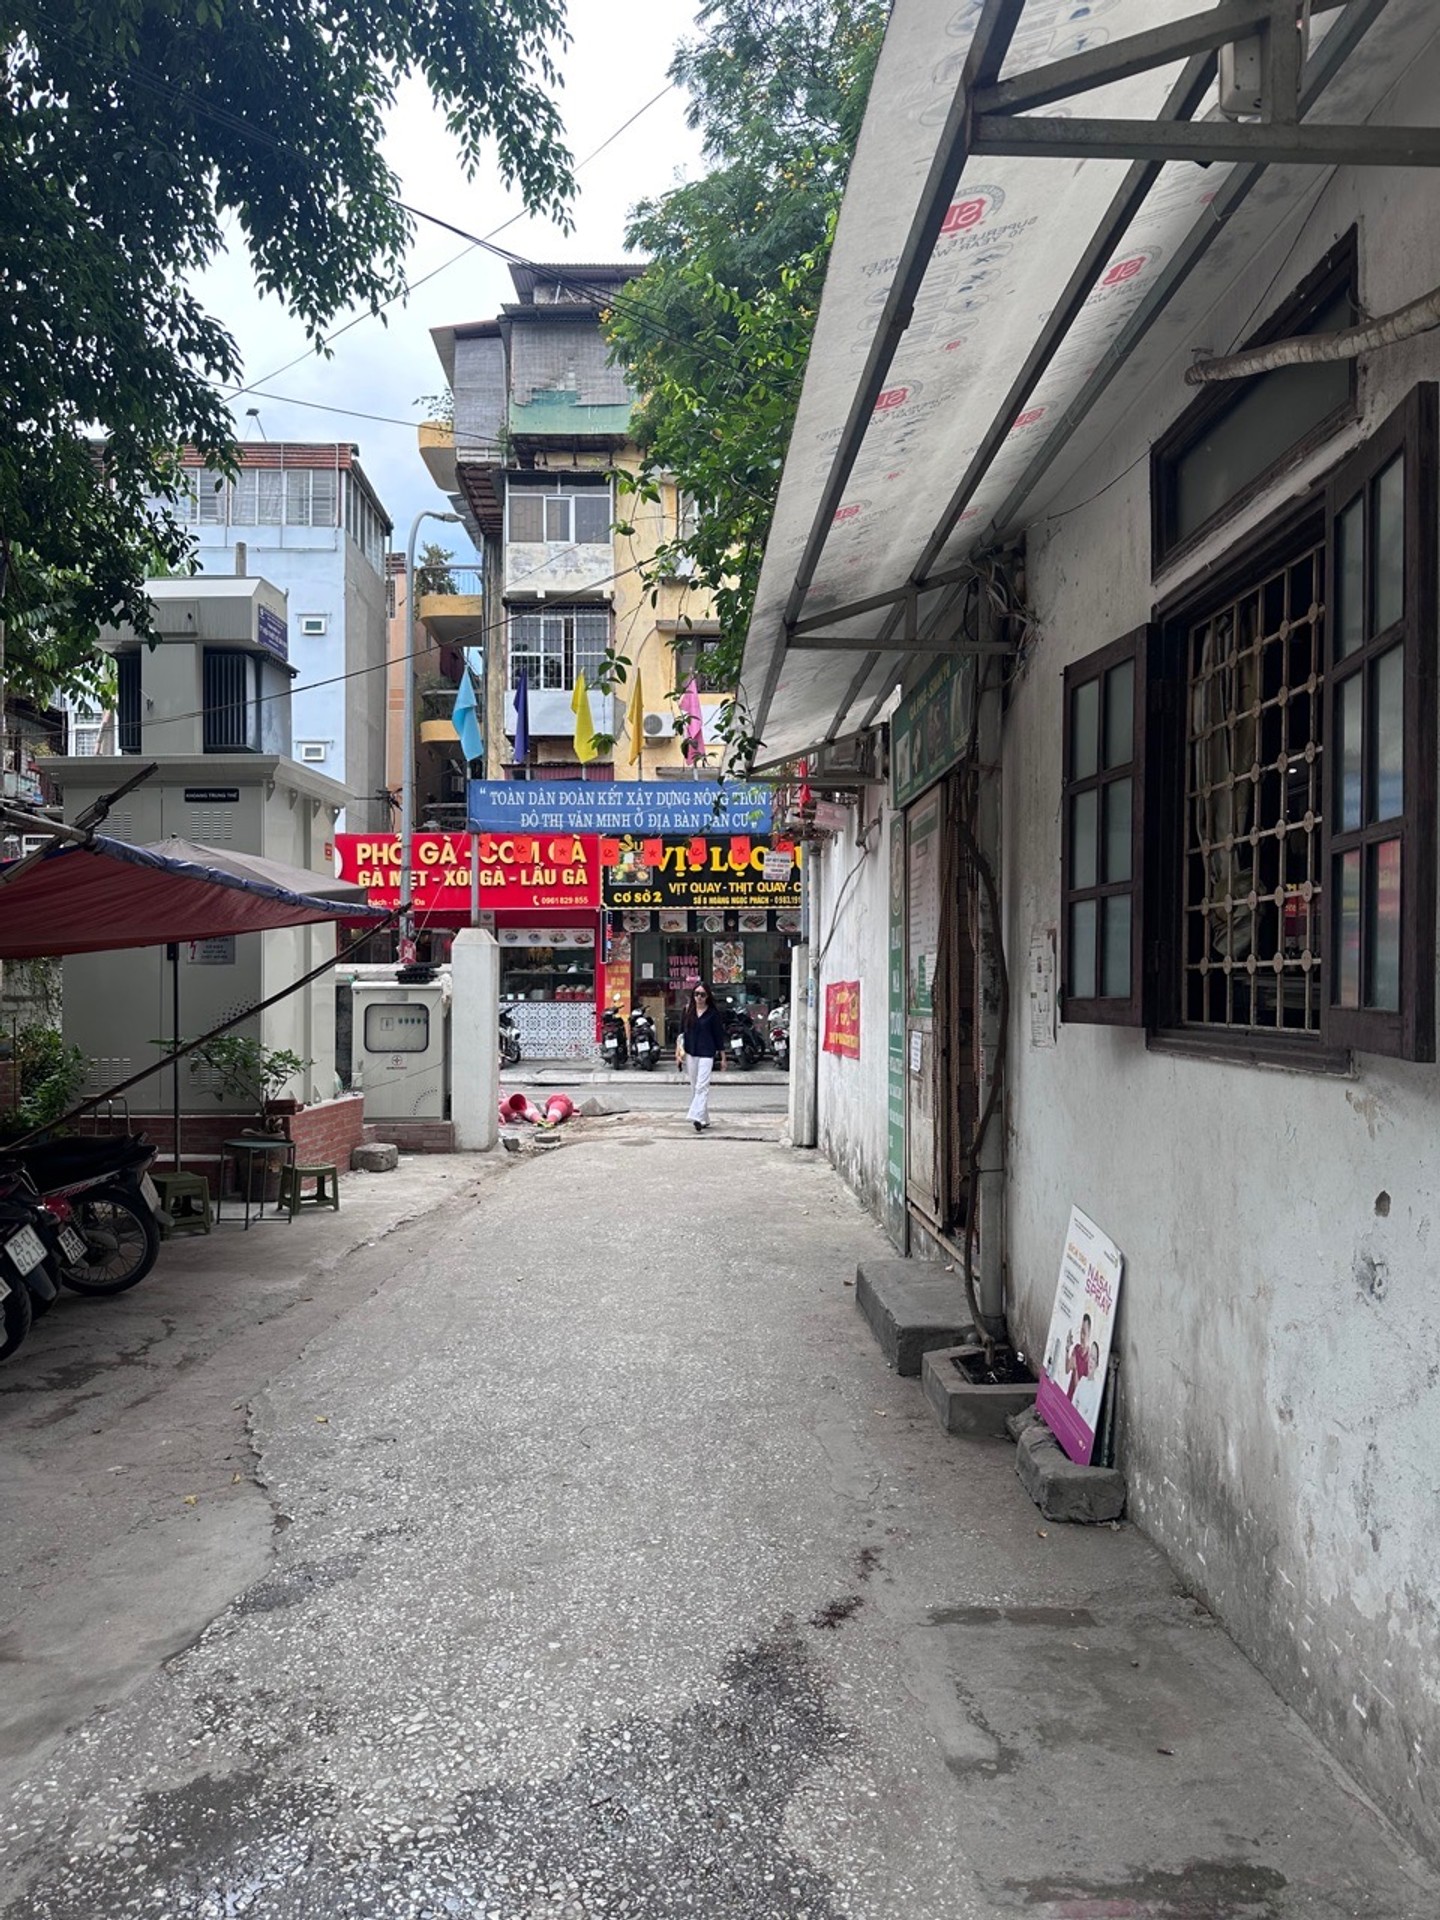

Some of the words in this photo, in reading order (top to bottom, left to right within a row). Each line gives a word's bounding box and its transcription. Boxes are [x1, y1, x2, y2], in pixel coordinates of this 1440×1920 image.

[490, 787, 525, 805] TOÀN
[528, 787, 555, 805] DÂN
[559, 787, 594, 805] ĐOÀN
[597, 785, 623, 805] KẾT
[626, 788, 651, 805] XÂY
[657, 790, 690, 809] DỰNG
[521, 809, 538, 827] ĐÔ
[542, 813, 562, 830] THỊ
[567, 810, 593, 828] VĂN
[596, 813, 631, 828] MINH
[634, 807, 644, 828] Ở
[648, 813, 671, 830] ĐỊA
[674, 810, 699, 828] BÀN
[419, 835, 458, 865] GÀ
[358, 867, 384, 887] GÀ
[480, 866, 506, 887] GÀ
[562, 864, 588, 886] GÀ
[669, 882, 688, 896] VỊT
[690, 882, 721, 894] QUAY
[729, 882, 754, 895] THỊT
[757, 882, 788, 893] QUAY
[1088, 1263, 1113, 1302] NASAL
[1085, 1278, 1112, 1316] SPRAY
